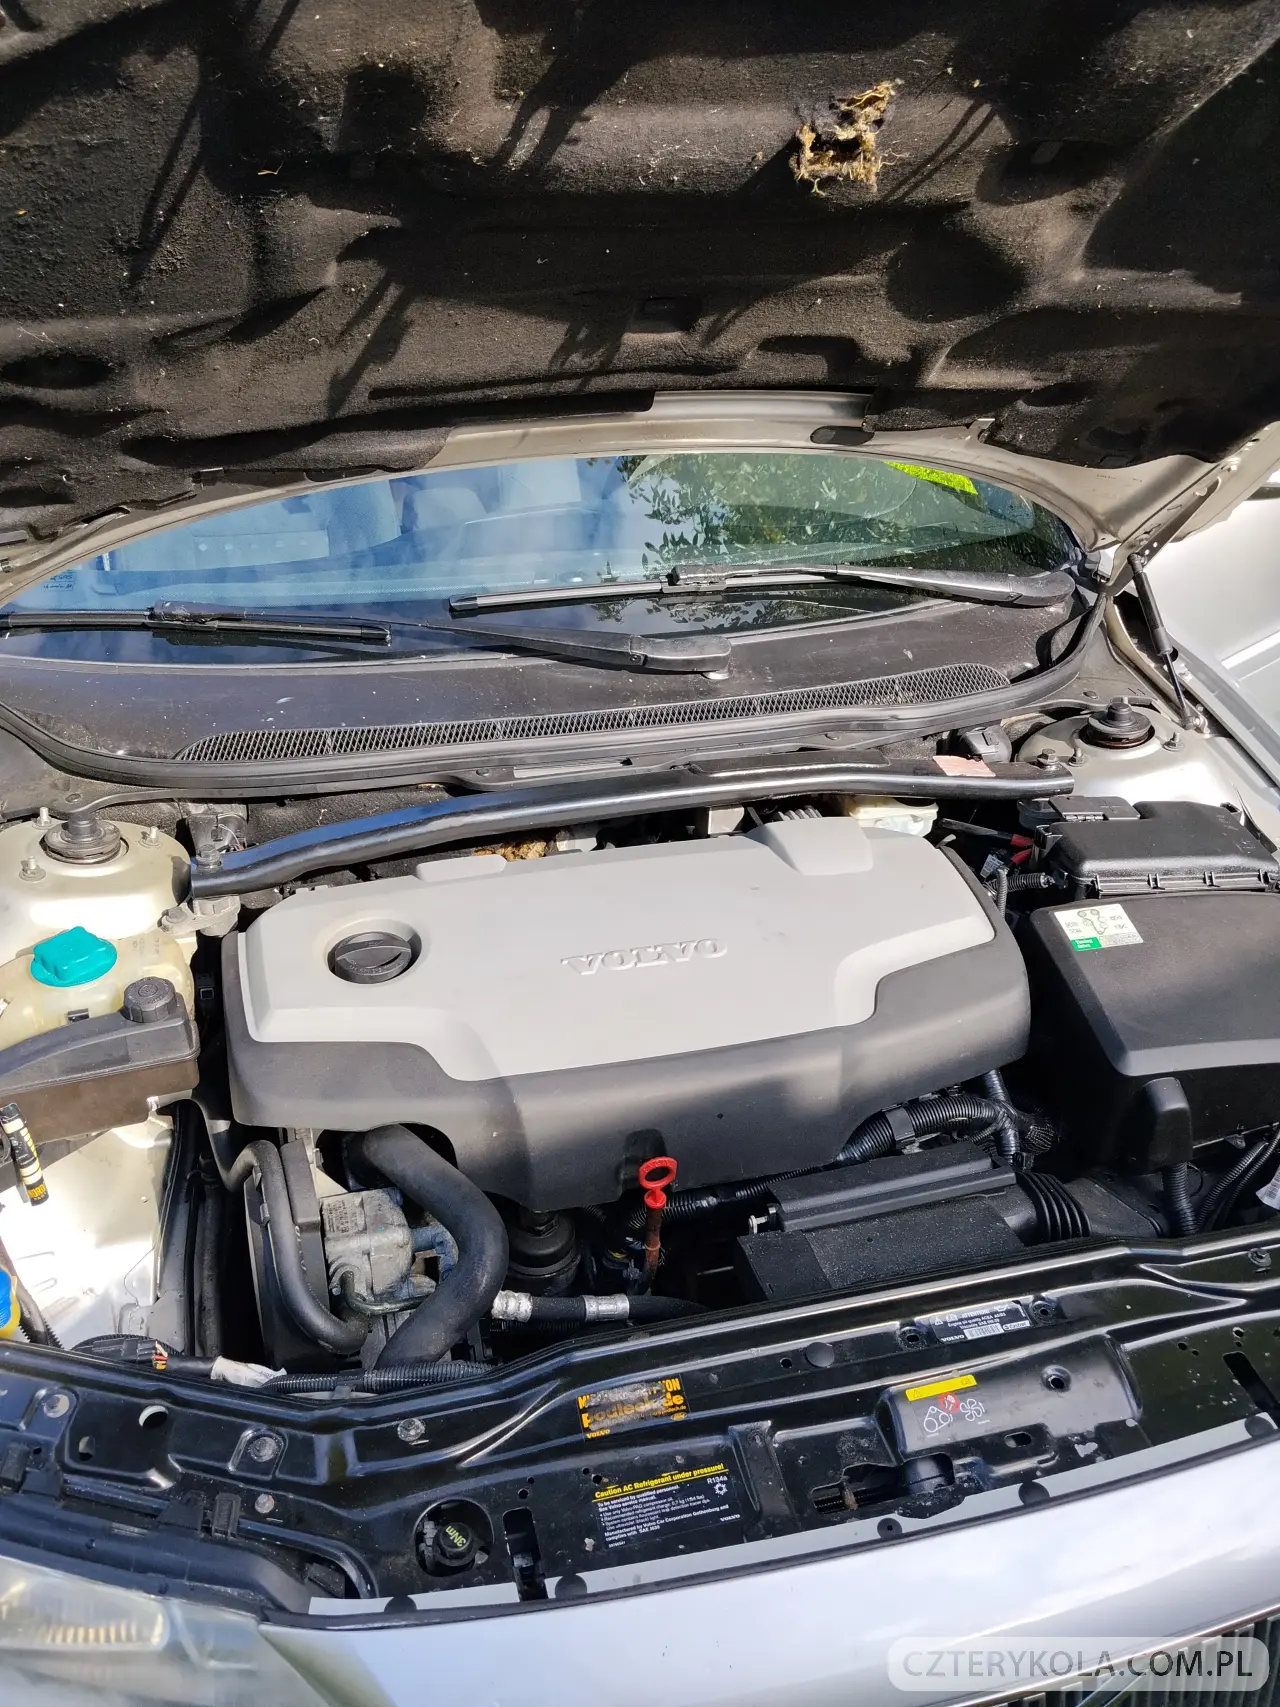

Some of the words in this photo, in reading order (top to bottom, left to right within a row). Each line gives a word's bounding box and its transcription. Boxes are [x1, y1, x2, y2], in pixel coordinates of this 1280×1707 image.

[561, 938, 728, 975] VOLVO
[586, 1429, 610, 1438] VOLVO
[595, 1488, 621, 1498] Caution
[634, 1476, 671, 1489] Refrigerant
[673, 1472, 691, 1480] under
[693, 1464, 724, 1476] pressure!
[707, 1476, 727, 1484] R134a
[446, 1526, 466, 1547] 3Nm
